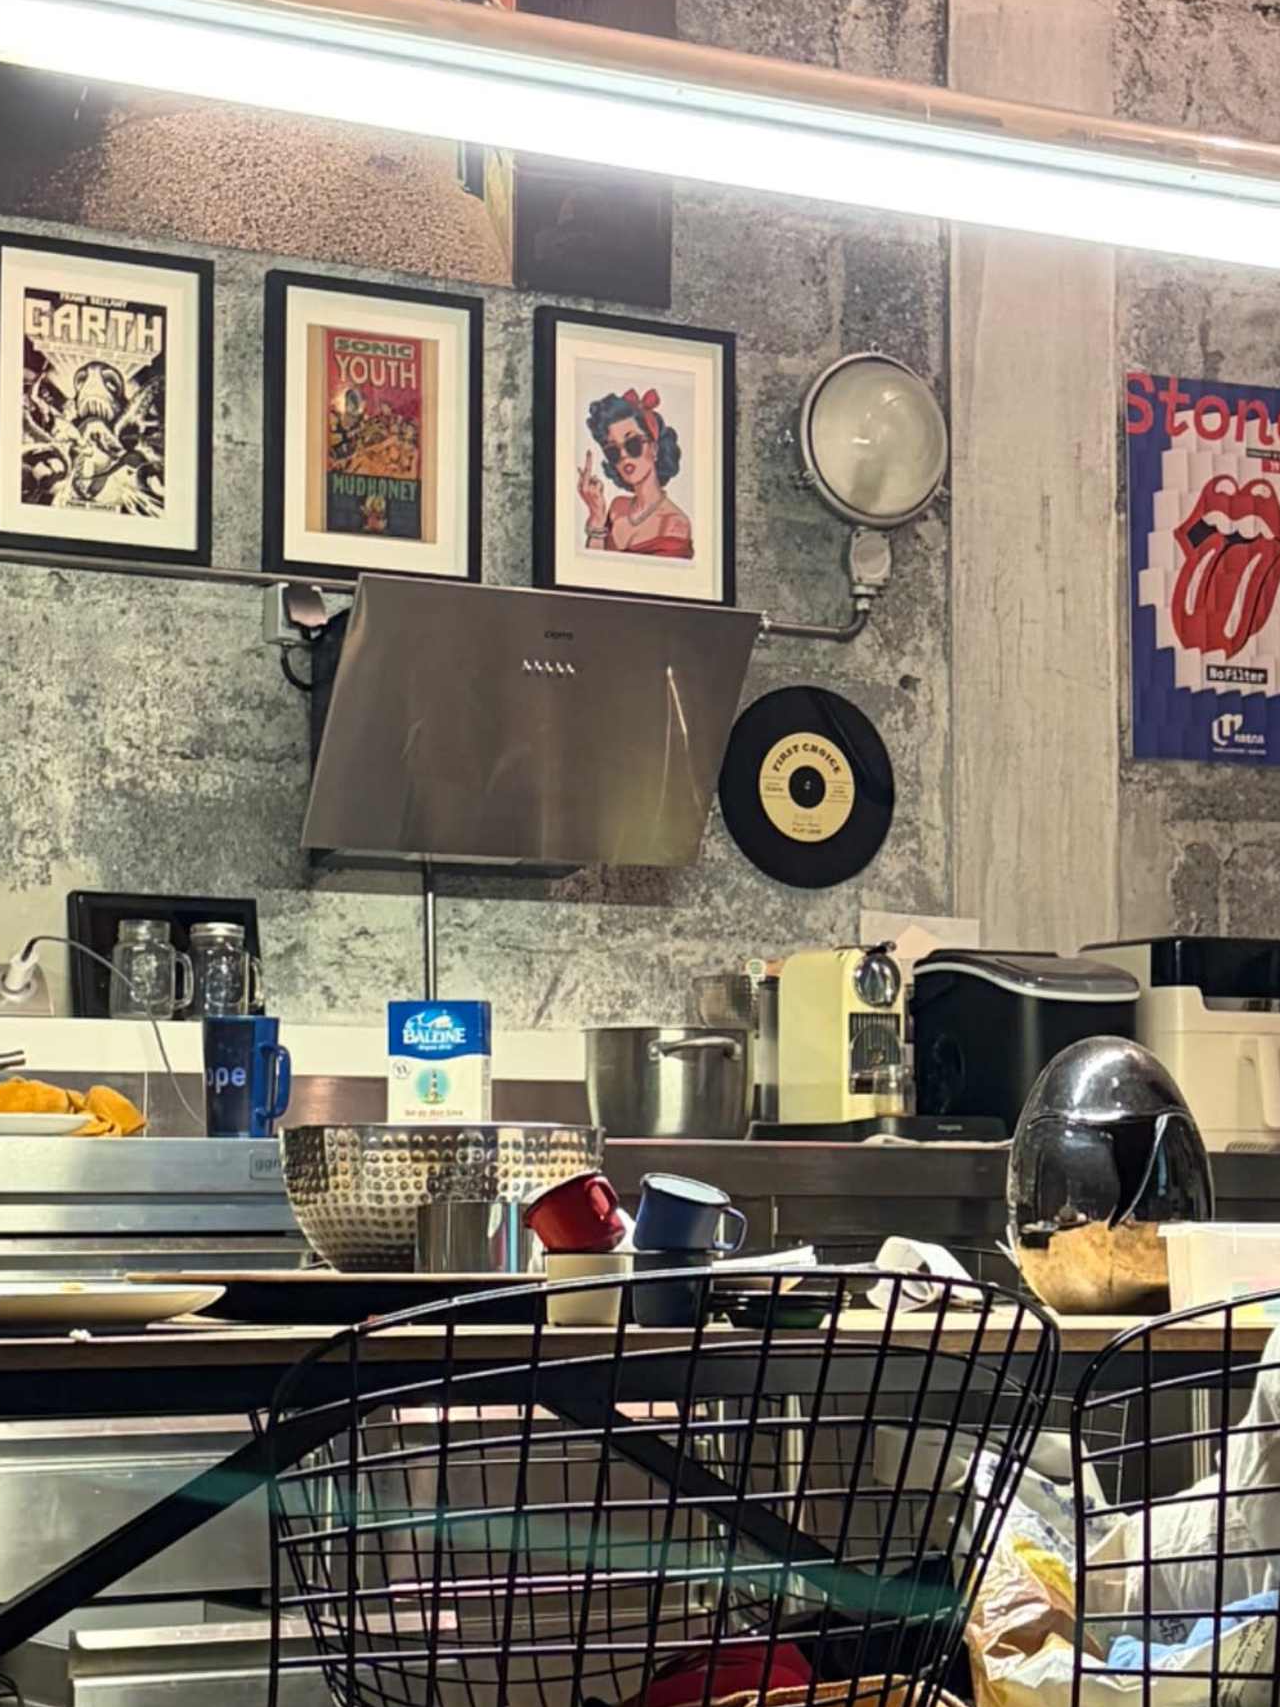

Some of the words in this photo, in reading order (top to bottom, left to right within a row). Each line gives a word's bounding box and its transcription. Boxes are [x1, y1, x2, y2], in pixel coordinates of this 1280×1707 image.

[24, 298, 162, 353] GARTH
[335, 338, 414, 358] SONIC
[335, 354, 417, 390] YOUTH
[332, 473, 418, 502] MUDHONEY
[772, 744, 799, 772] FIRST
[802, 743, 841, 774] CHOICE
